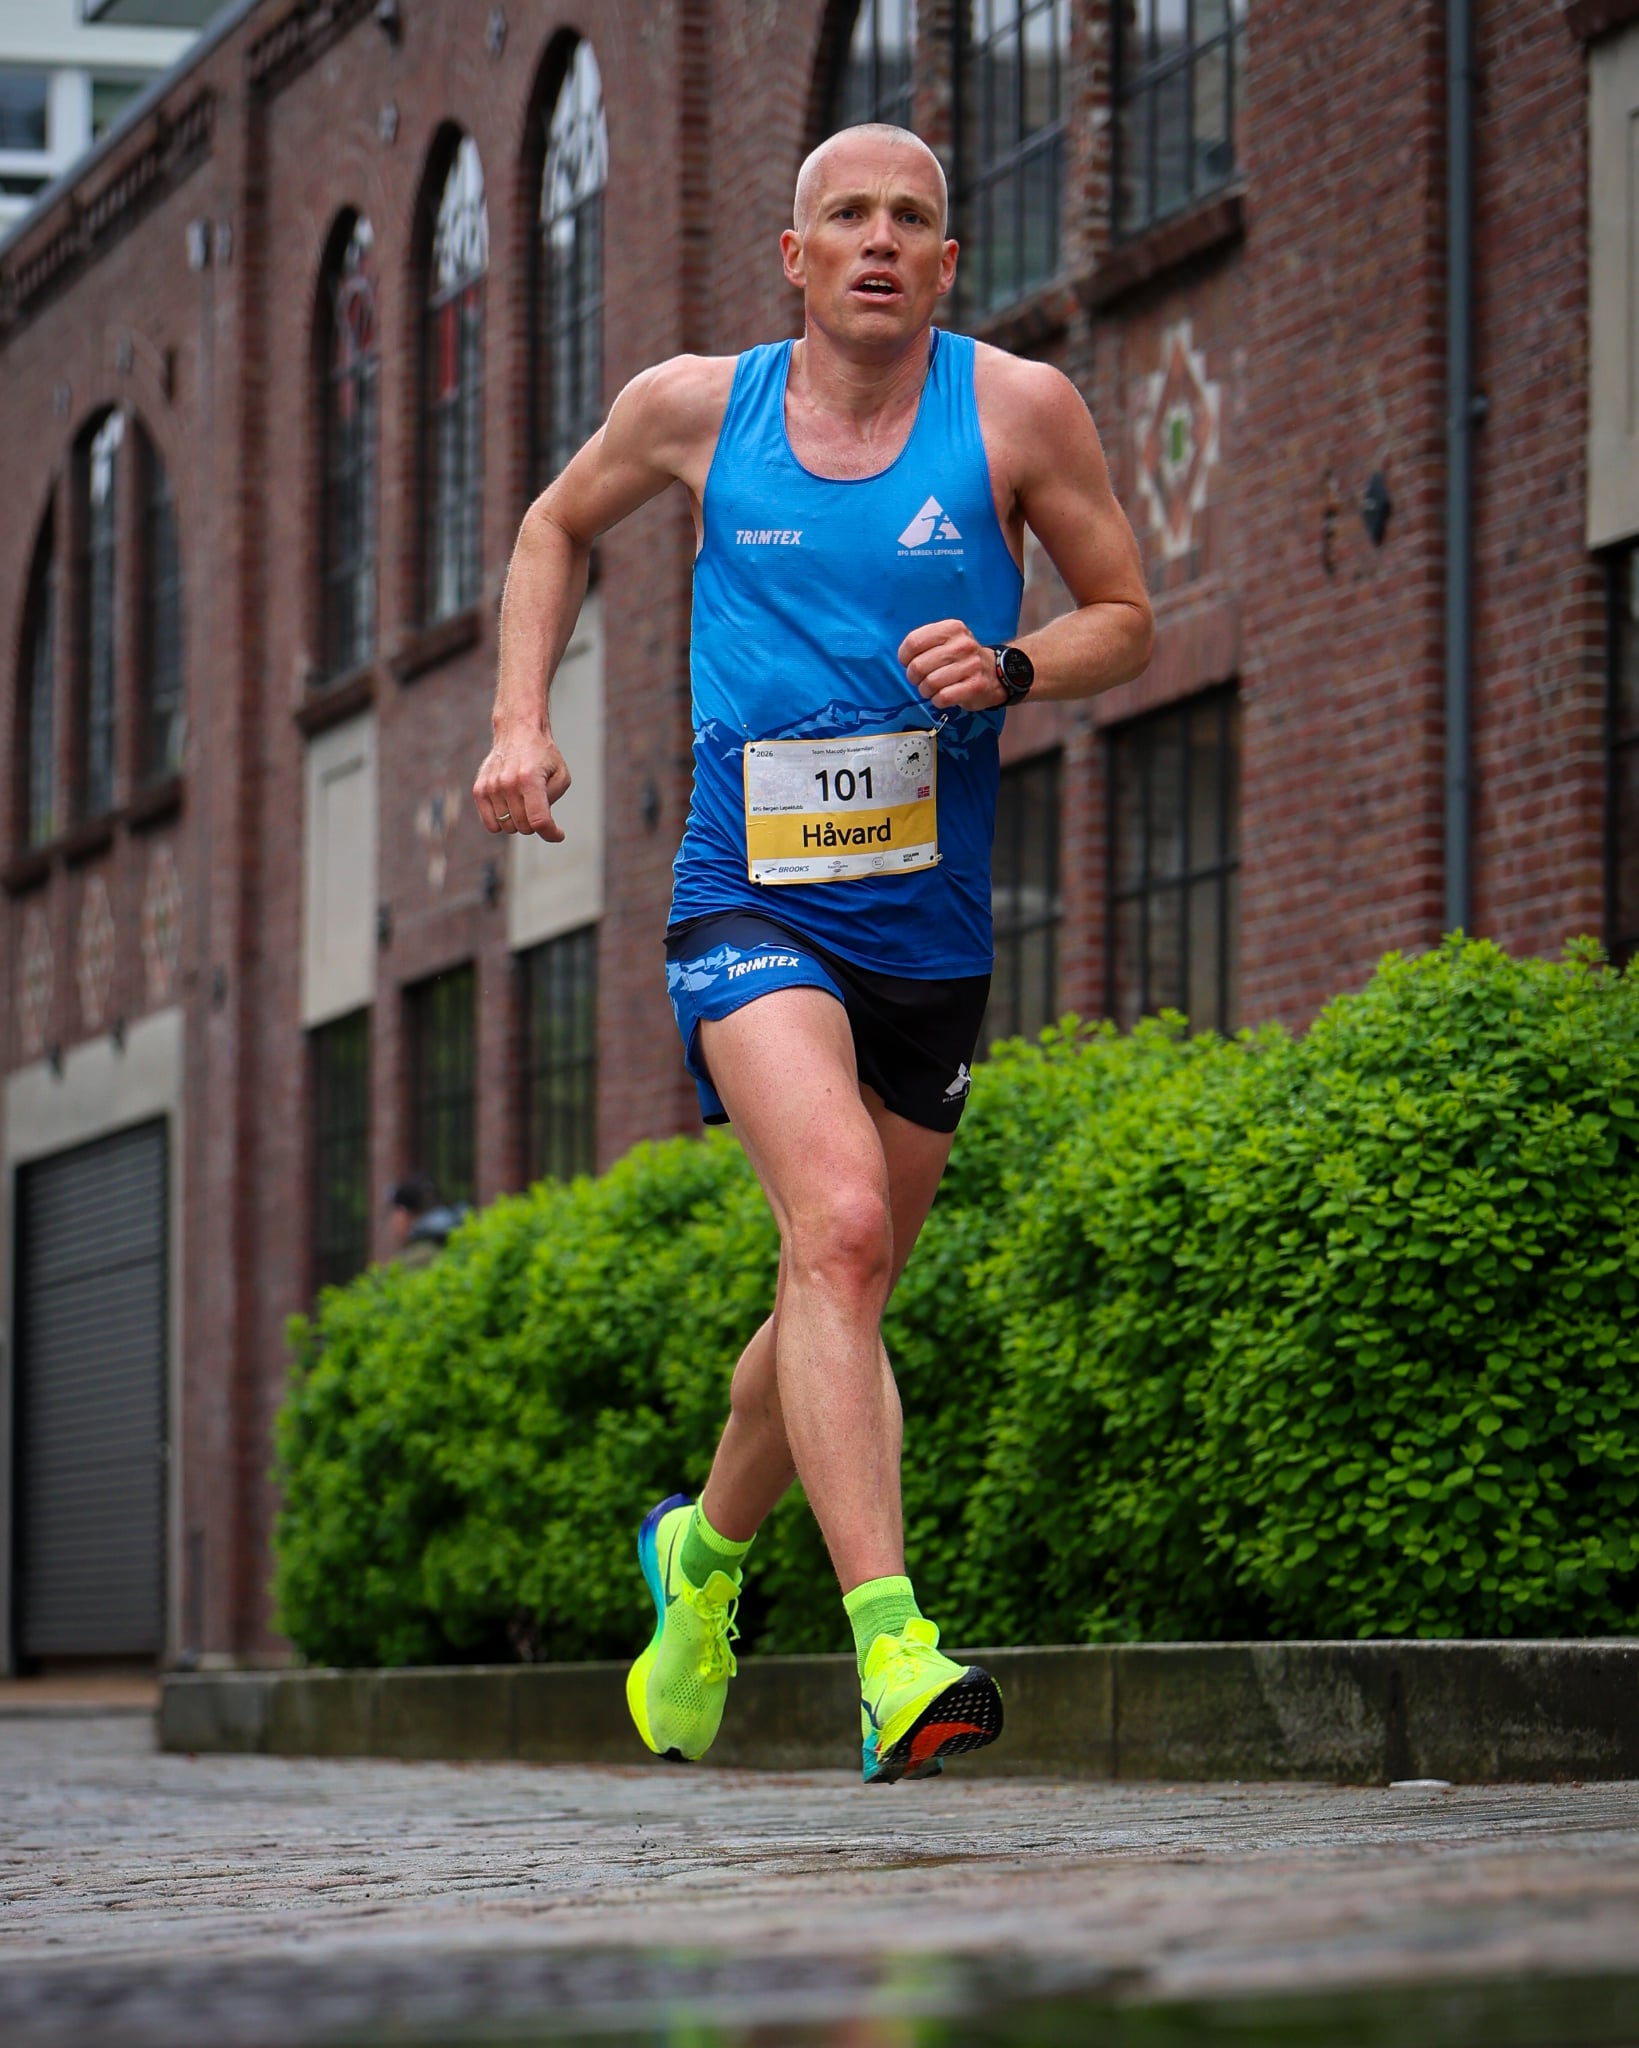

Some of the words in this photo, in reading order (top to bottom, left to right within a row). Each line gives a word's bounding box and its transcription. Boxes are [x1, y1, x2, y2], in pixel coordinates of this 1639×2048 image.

[736, 530, 803, 545] TRIMTEX
[756, 750, 774, 758] 2026
[815, 766, 873, 802] 101
[803, 817, 891, 848] Håvard
[778, 865, 810, 873] BROOKS
[727, 955, 800, 980] TRIMTEX
